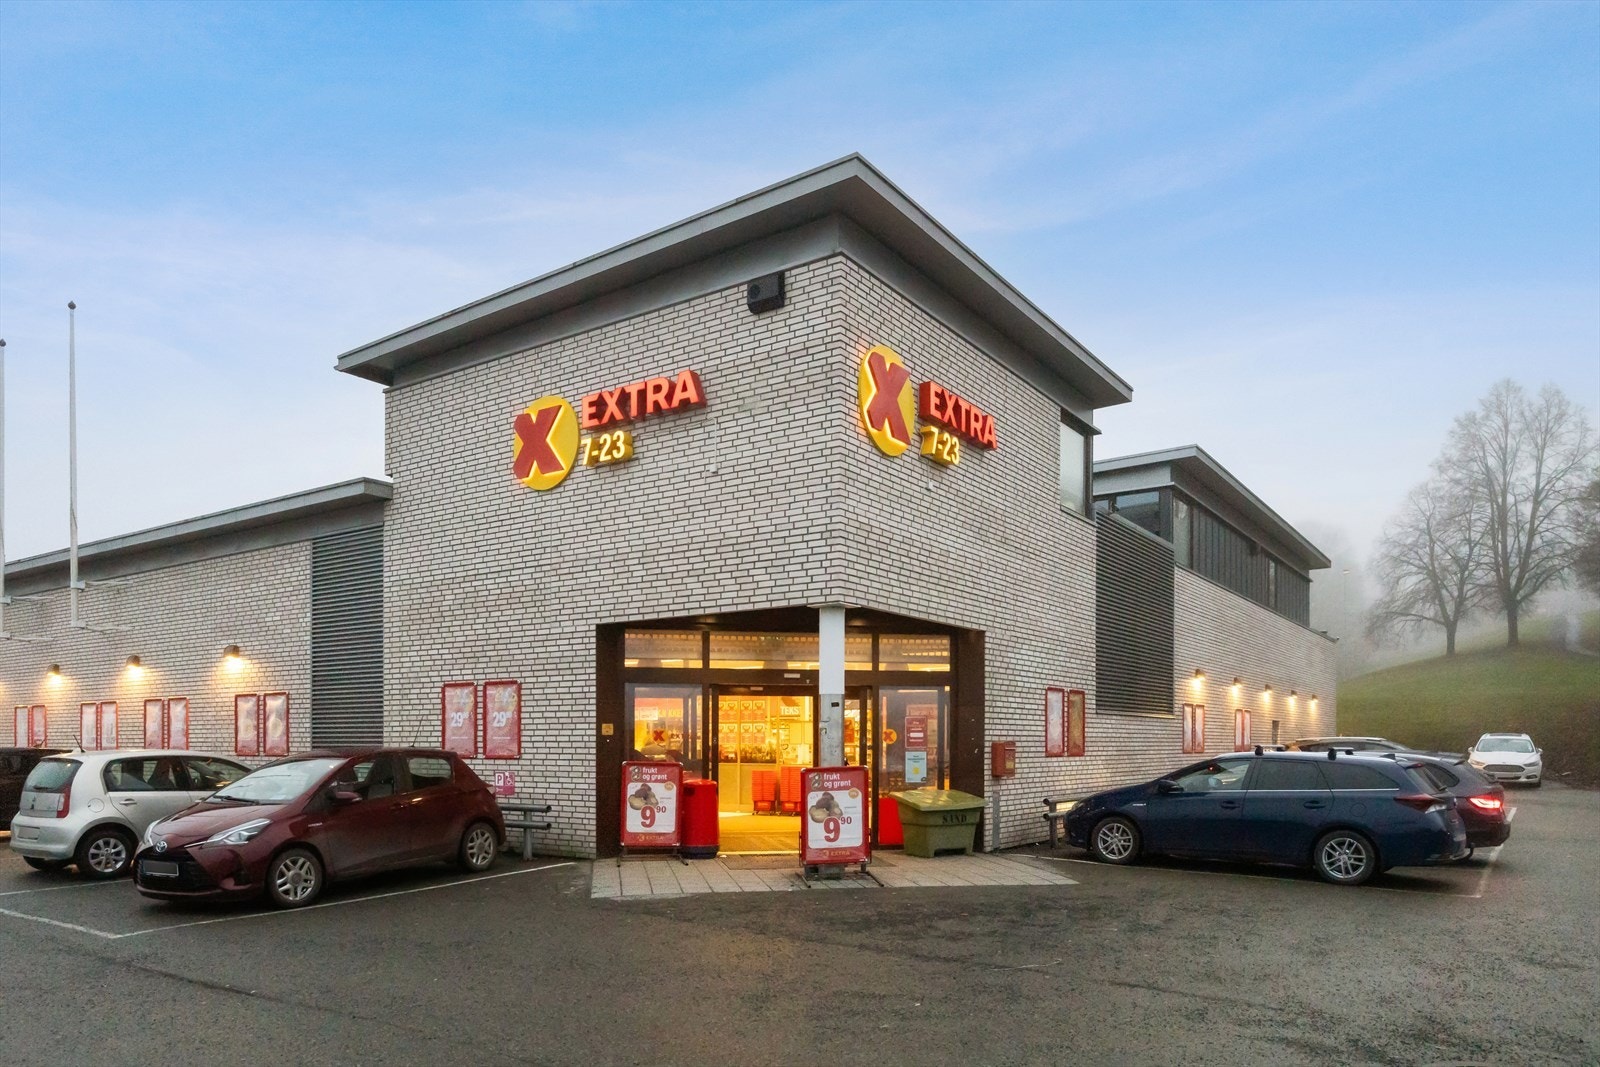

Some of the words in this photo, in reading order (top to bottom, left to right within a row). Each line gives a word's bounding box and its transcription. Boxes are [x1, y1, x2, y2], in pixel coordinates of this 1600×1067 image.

[581, 370, 704, 428] EXTRA
[866, 351, 912, 446] X
[929, 381, 997, 449] EXTRA
[513, 404, 565, 480] X
[581, 430, 625, 466] 7-23
[931, 425, 960, 465] 7-23
[451, 712, 464, 727] 29
[493, 712, 506, 727] 29
[640, 805, 656, 828] 9
[656, 805, 667, 813] 90
[823, 817, 840, 843] 9
[840, 816, 852, 825] 90
[942, 814, 967, 824] SAND
